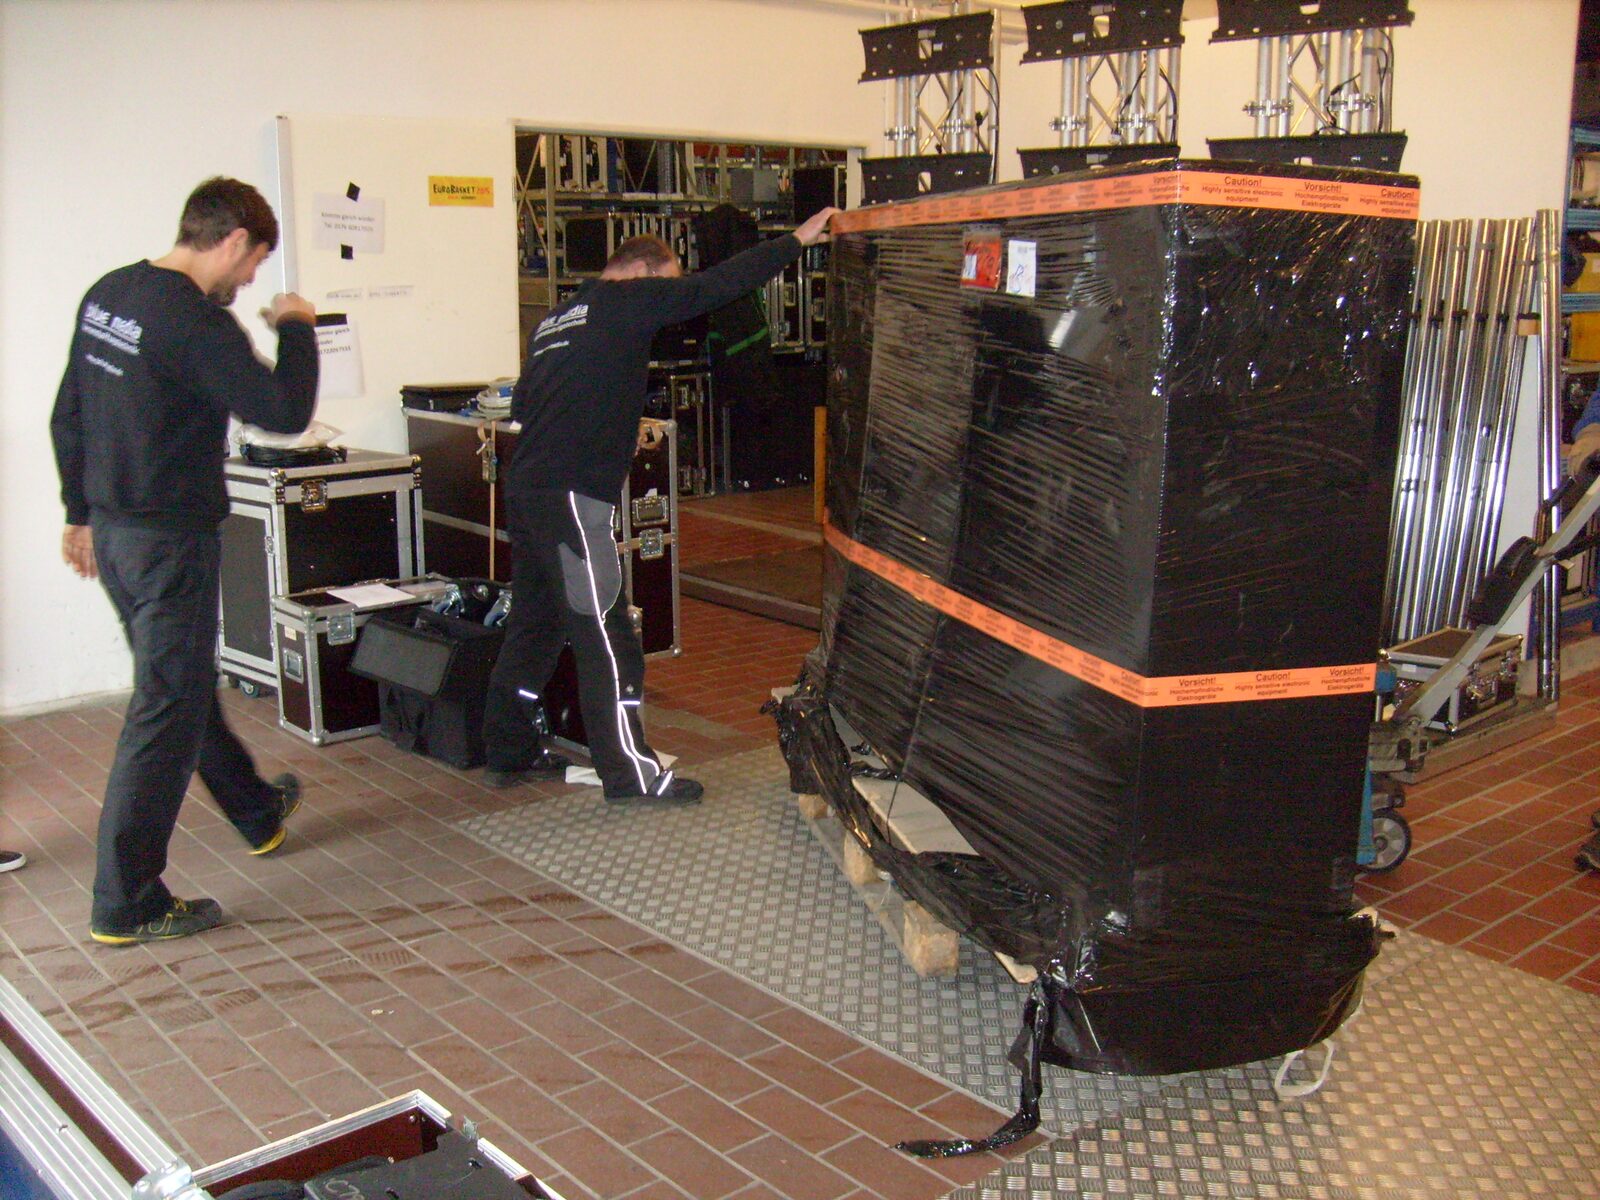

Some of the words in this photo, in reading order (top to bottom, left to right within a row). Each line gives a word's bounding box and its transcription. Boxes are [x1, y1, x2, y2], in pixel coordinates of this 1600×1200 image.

[1224, 175, 1262, 187] Caution!
[1304, 181, 1342, 192] Vorsicht!
[1202, 185, 1222, 195] Highly
[1381, 188, 1415, 199] Caution!
[1256, 671, 1291, 682] Caution!
[1329, 666, 1365, 677] Vorsicht!
[1179, 677, 1217, 687] Vorsicht!
